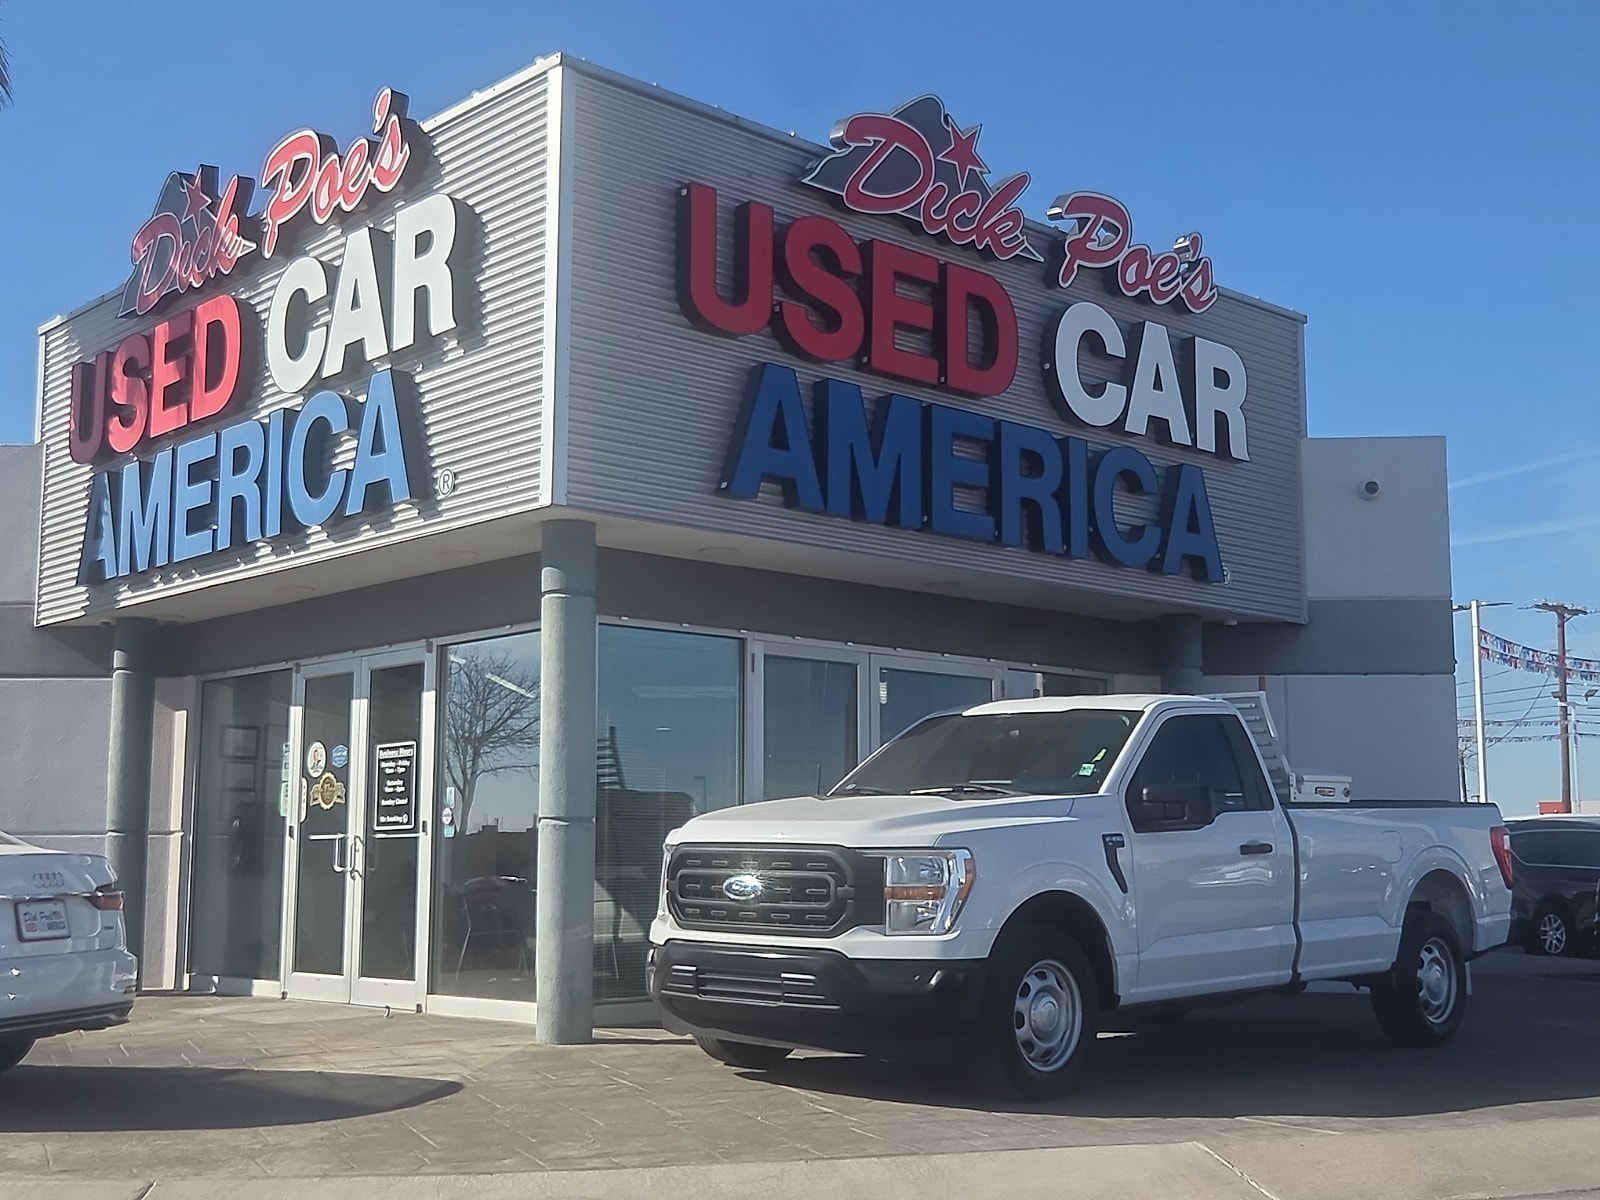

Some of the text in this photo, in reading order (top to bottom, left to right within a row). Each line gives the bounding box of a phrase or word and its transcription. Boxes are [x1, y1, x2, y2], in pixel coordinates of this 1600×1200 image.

[131, 87, 410, 315] Dick Poe's
[842, 112, 1218, 313] Dick Poe's
[69, 194, 457, 464] USED CAR
[686, 182, 1250, 463] USED CAR
[78, 369, 411, 584] AMERICA
[729, 362, 1226, 584] AMERICA
